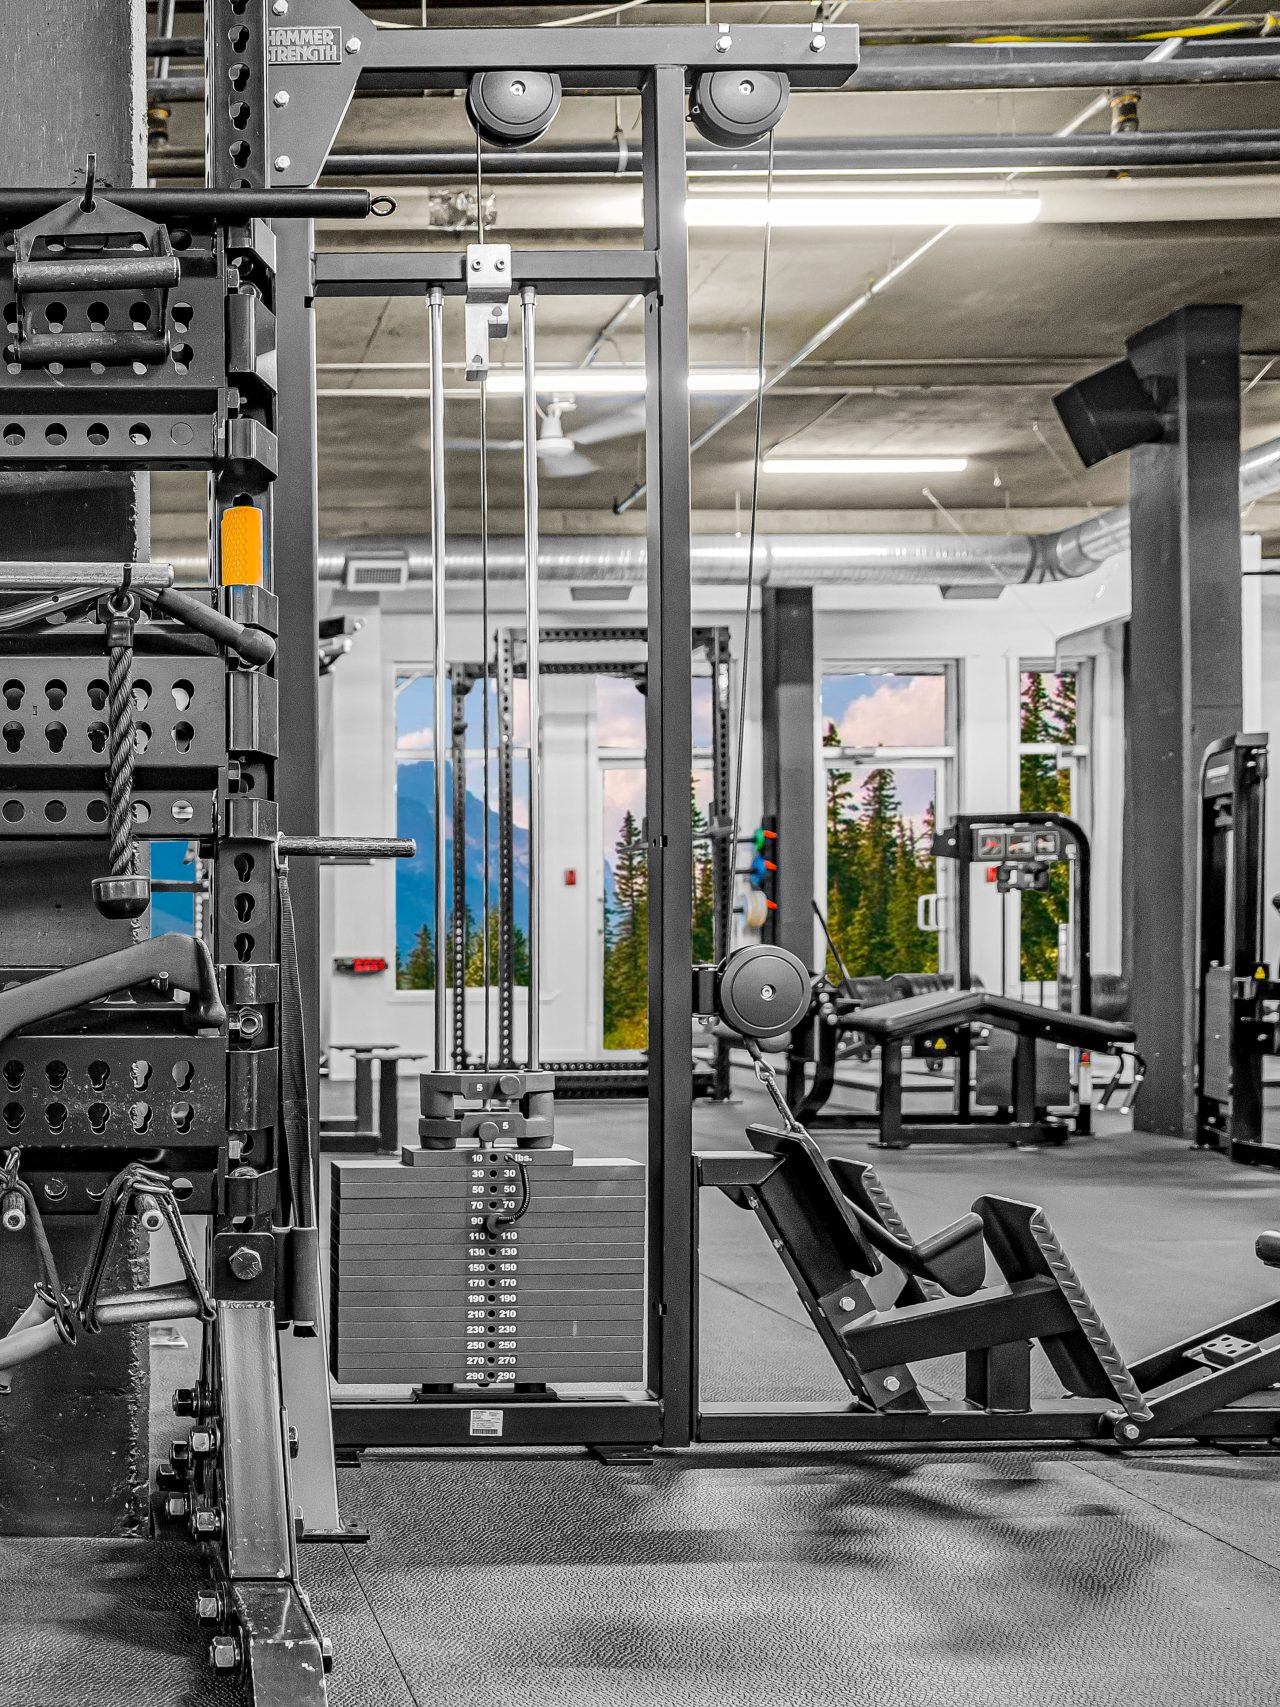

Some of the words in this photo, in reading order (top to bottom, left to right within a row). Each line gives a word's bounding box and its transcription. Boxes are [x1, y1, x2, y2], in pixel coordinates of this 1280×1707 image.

[268, 29, 334, 46] HAMMER
[268, 45, 337, 61] TRENGTH
[476, 1083, 483, 1092] 5
[502, 1121, 509, 1130] 5
[471, 1154, 483, 1162] 10
[514, 1153, 533, 1162] lbs.
[471, 1169, 485, 1178] 30
[503, 1169, 516, 1178] 30
[471, 1185, 485, 1194] 50
[503, 1185, 516, 1193] 50
[470, 1201, 484, 1210] 70
[502, 1200, 516, 1209] 70
[470, 1216, 484, 1225] 90
[469, 1232, 486, 1240] 110
[501, 1232, 518, 1240] 110
[468, 1248, 486, 1256] 130
[500, 1247, 518, 1256] 130
[468, 1263, 486, 1272] 150
[500, 1263, 517, 1271] 150
[468, 1279, 485, 1287] 170
[499, 1278, 517, 1287] 170
[467, 1294, 485, 1303] 190
[499, 1294, 517, 1303] 190
[467, 1310, 485, 1319] 210
[498, 1309, 517, 1318] 210
[466, 1325, 485, 1334] 230
[498, 1325, 516, 1333] 230
[466, 1341, 485, 1350] 250
[498, 1341, 516, 1349] 250
[466, 1356, 485, 1365] 270
[497, 1356, 516, 1365] 270
[465, 1372, 484, 1380] 290
[497, 1371, 516, 1380] 290
